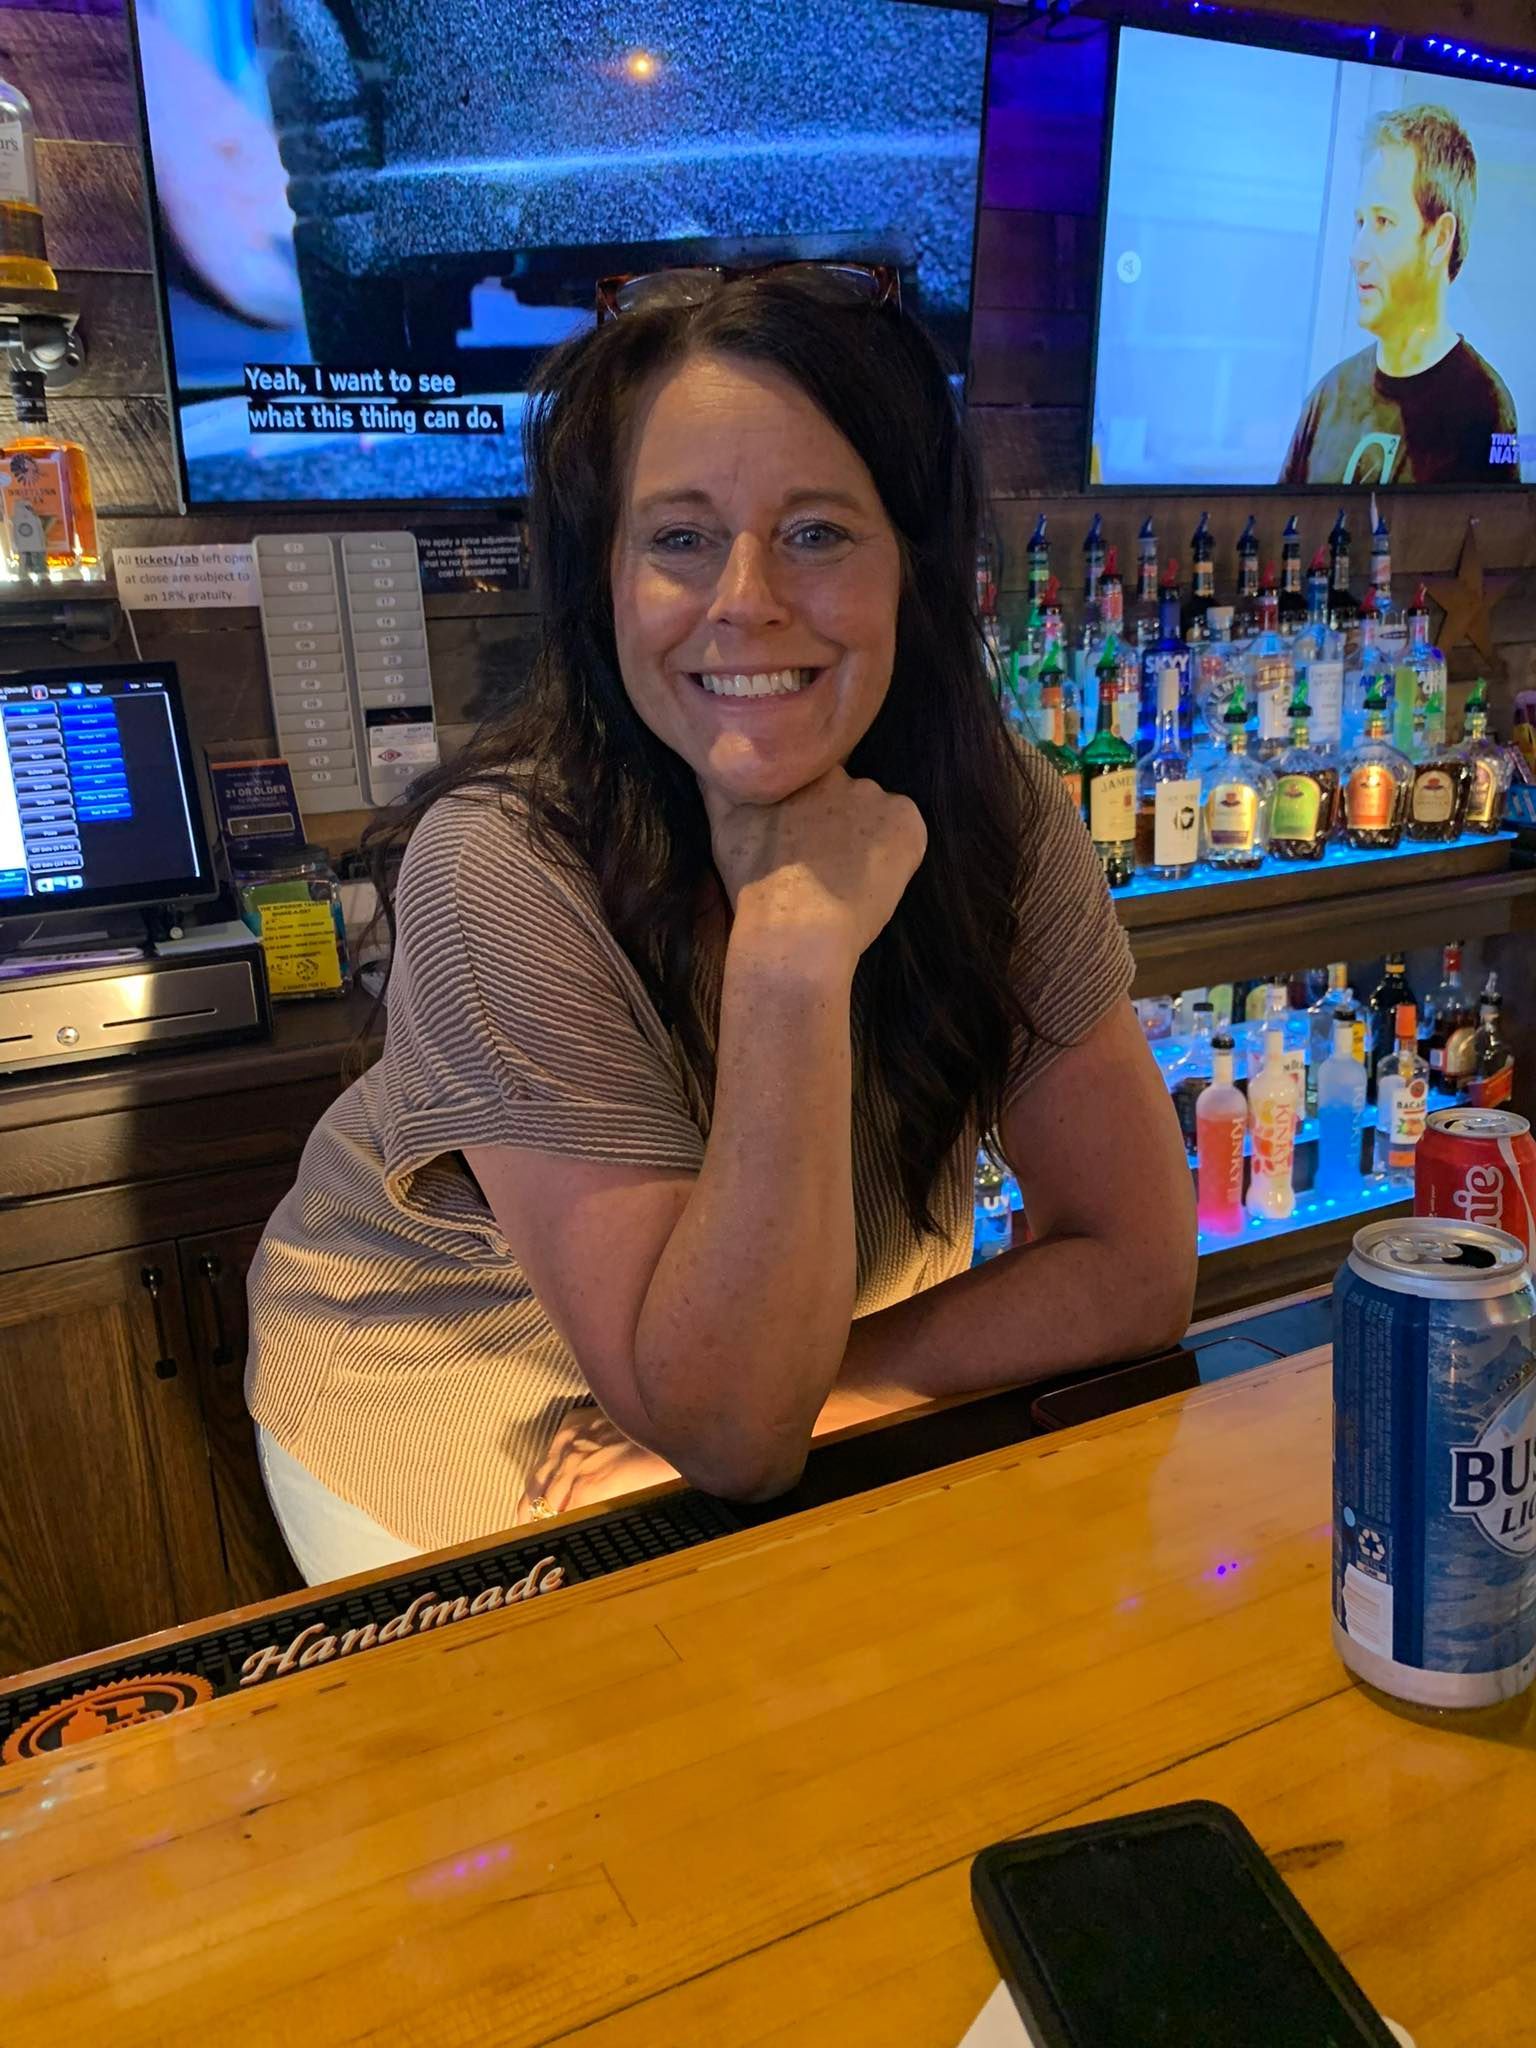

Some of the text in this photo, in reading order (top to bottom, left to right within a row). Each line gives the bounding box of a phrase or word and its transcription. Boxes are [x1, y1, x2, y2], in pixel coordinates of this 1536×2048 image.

[245, 367, 456, 394] Yeah, I want to see
[250, 404, 499, 434] what this thing can do.
[418, 538, 431, 547] We
[432, 538, 454, 548] apply
[461, 537, 480, 548] price
[481, 535, 521, 546] adjustment
[426, 548, 437, 558] on
[473, 545, 518, 556] transactions
[117, 553, 253, 567] All tickets/tab left open
[423, 558, 439, 568] that
[440, 558, 448, 567] is
[448, 557, 461, 568] not
[461, 557, 488, 568] greater
[490, 555, 507, 566] than
[124, 571, 250, 588] at close are subject to
[438, 568, 455, 578] cost
[456, 567, 463, 577] of
[143, 591, 158, 602] an
[162, 590, 186, 602] 18%
[1144, 653, 1189, 675] SKYY
[224, 788, 237, 799] 21
[237, 786, 252, 798] OR
[253, 783, 287, 796] OLDER
[1275, 1103, 1290, 1163] KINKY
[1231, 1117, 1245, 1178] KINKY
[239, 1555, 565, 1687] Handmade
